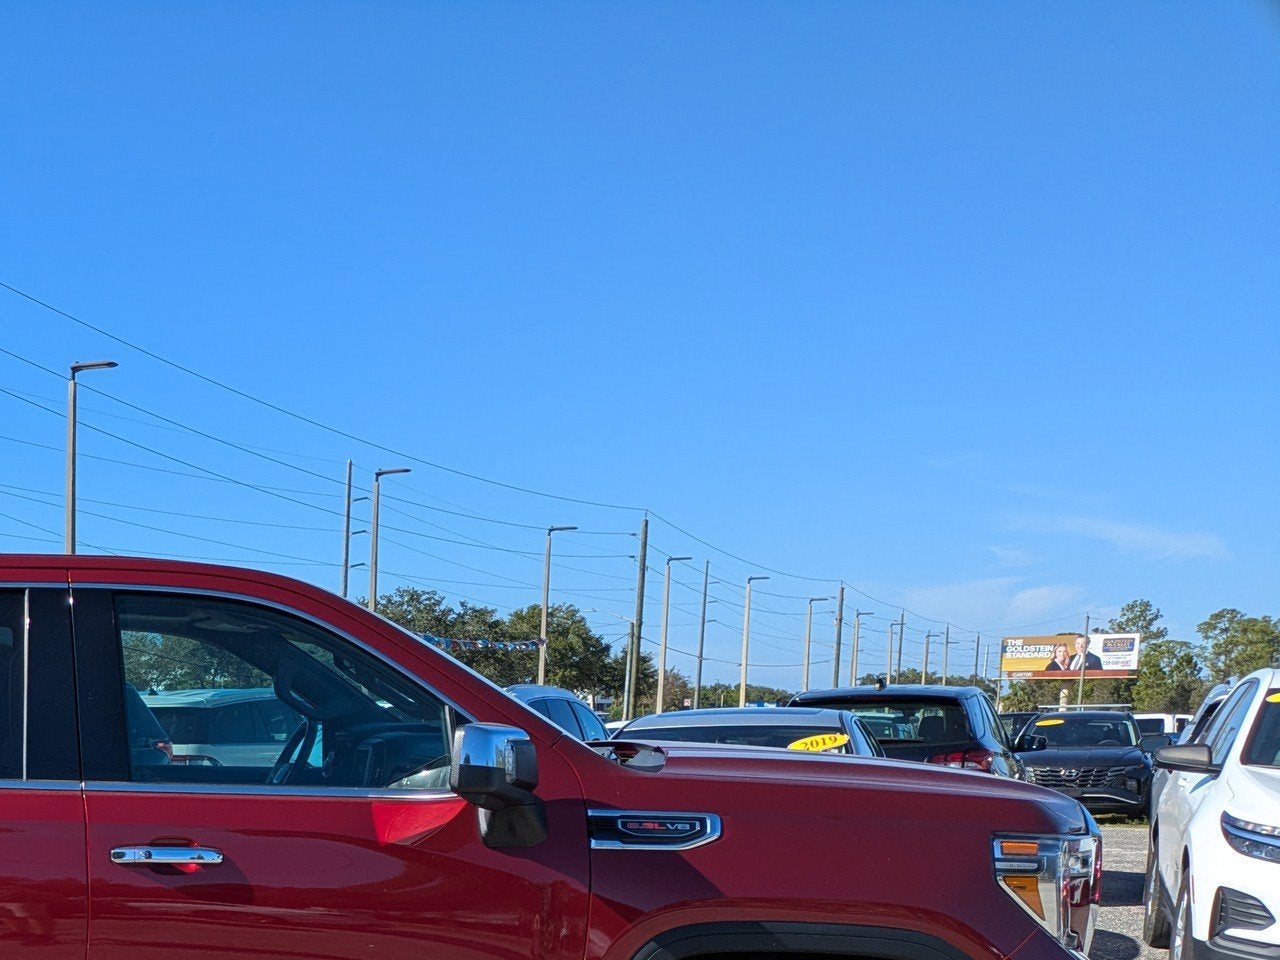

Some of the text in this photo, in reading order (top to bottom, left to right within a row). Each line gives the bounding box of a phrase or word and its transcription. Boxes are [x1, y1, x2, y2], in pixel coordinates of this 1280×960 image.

[1005, 645, 1054, 653] GOLDSTEIN
[1005, 651, 1052, 659] STANDARD
[800, 735, 838, 751] 2019
